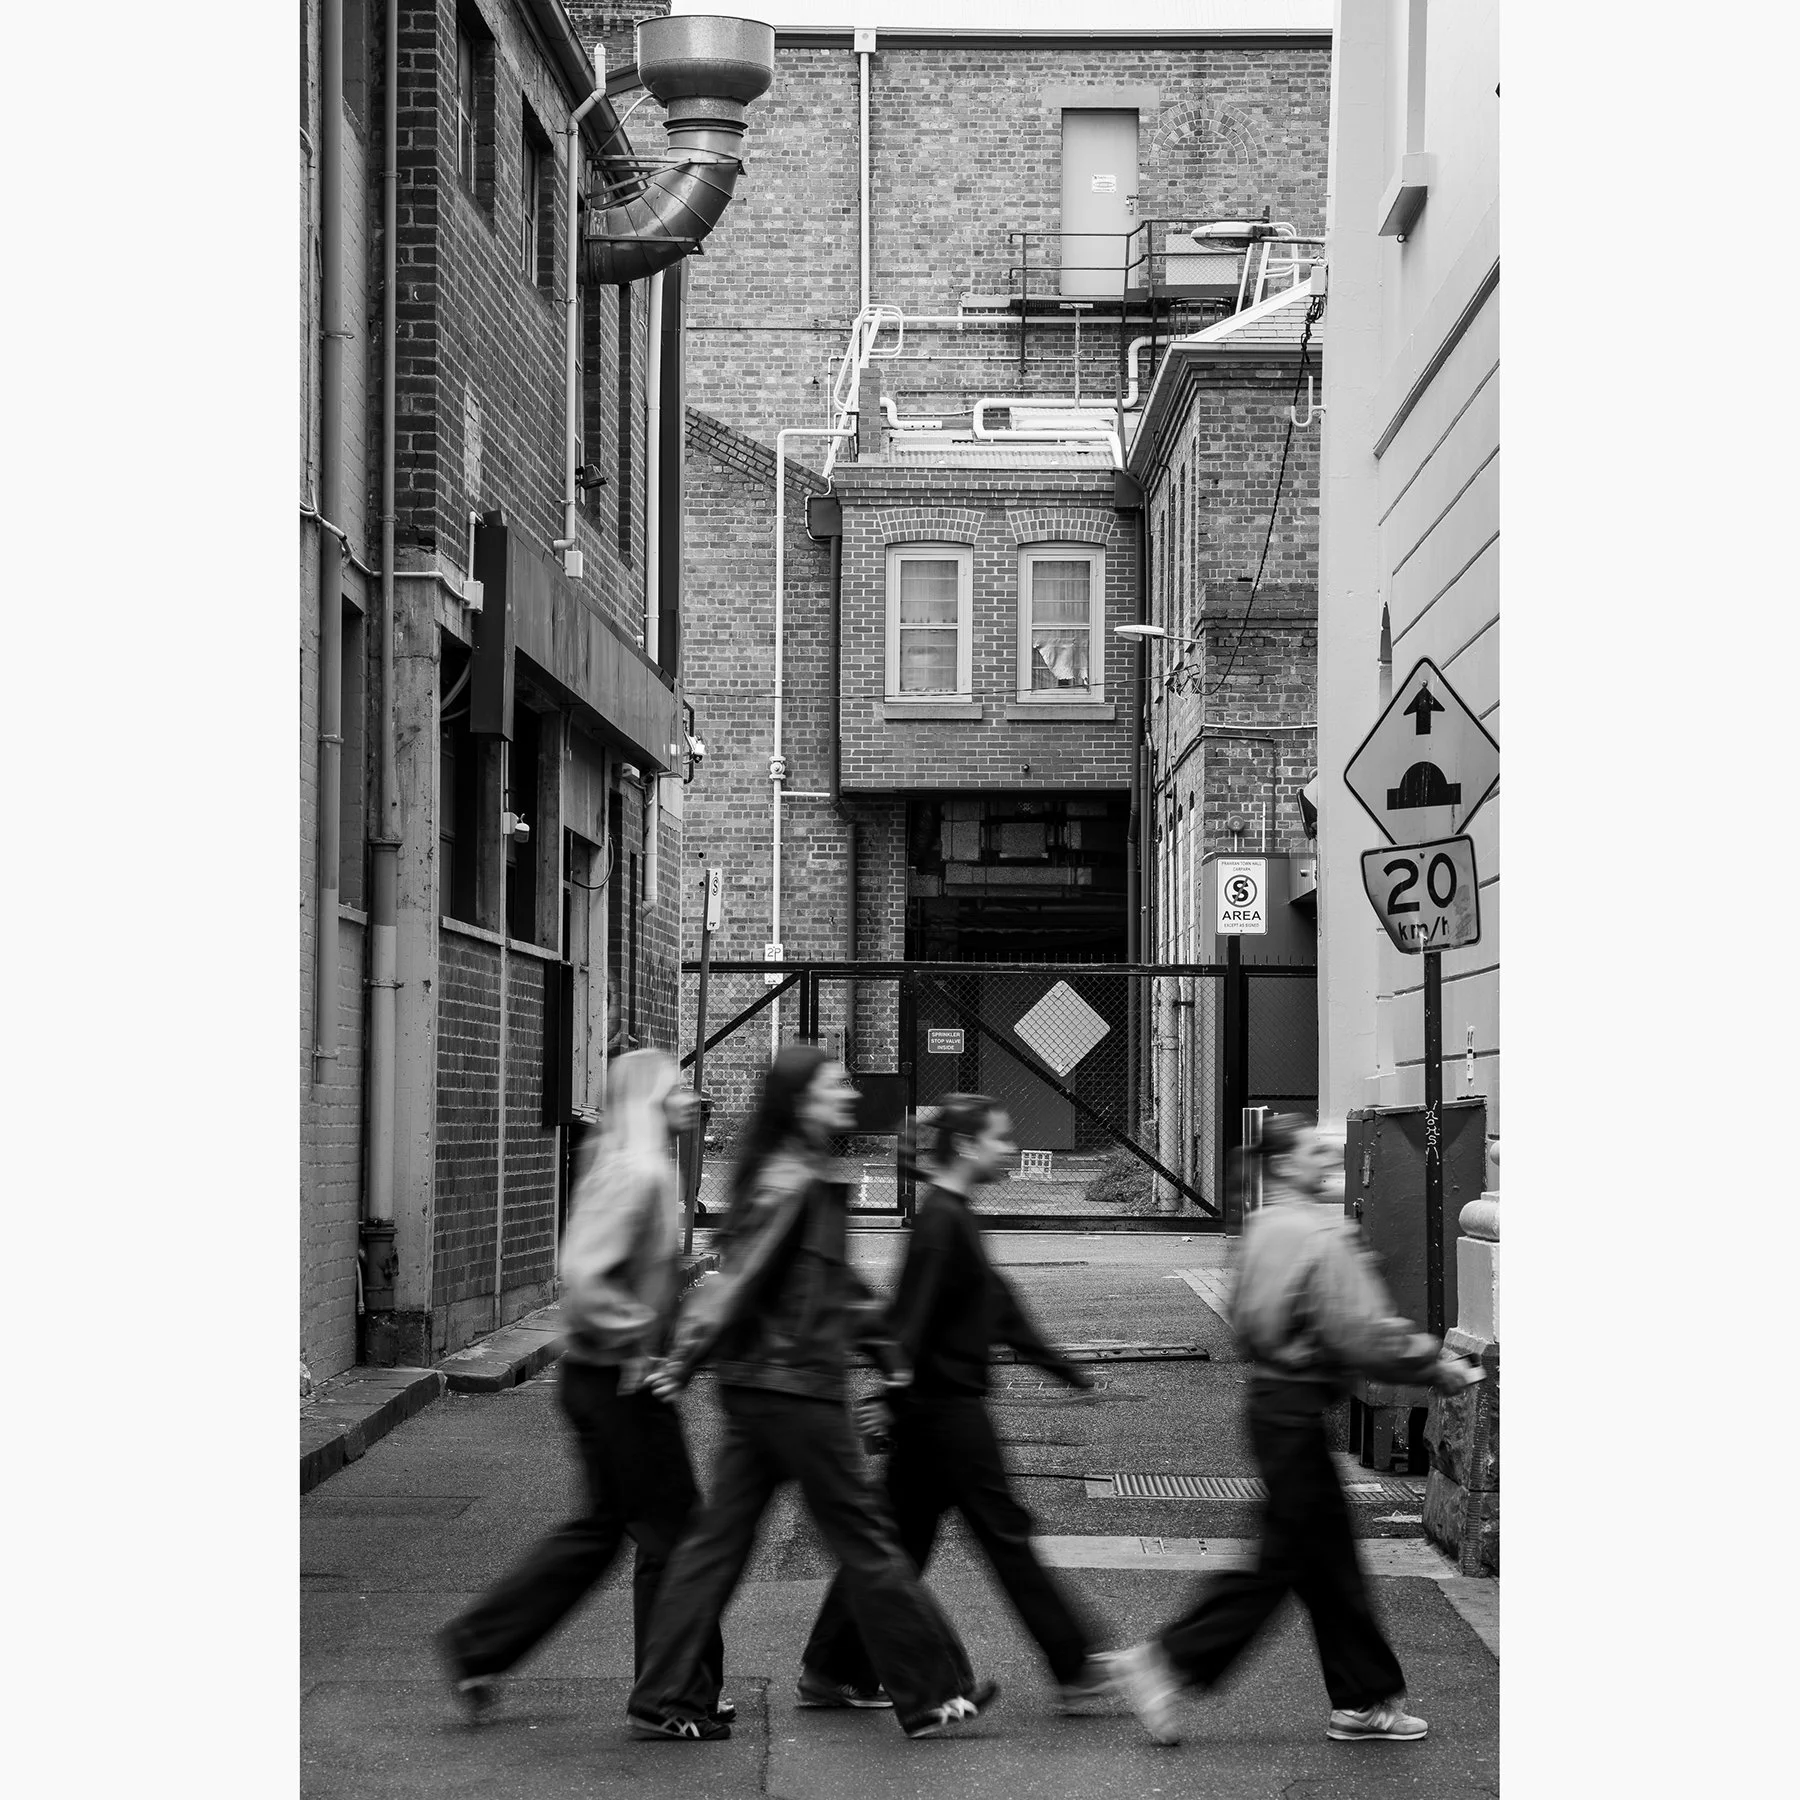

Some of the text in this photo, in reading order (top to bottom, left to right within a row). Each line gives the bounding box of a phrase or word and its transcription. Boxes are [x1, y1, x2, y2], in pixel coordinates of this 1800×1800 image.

[1383, 852, 1457, 915] 20
[1222, 911, 1262, 920] AREA
[1398, 916, 1450, 941] km/h
[767, 947, 781, 961] 2P
